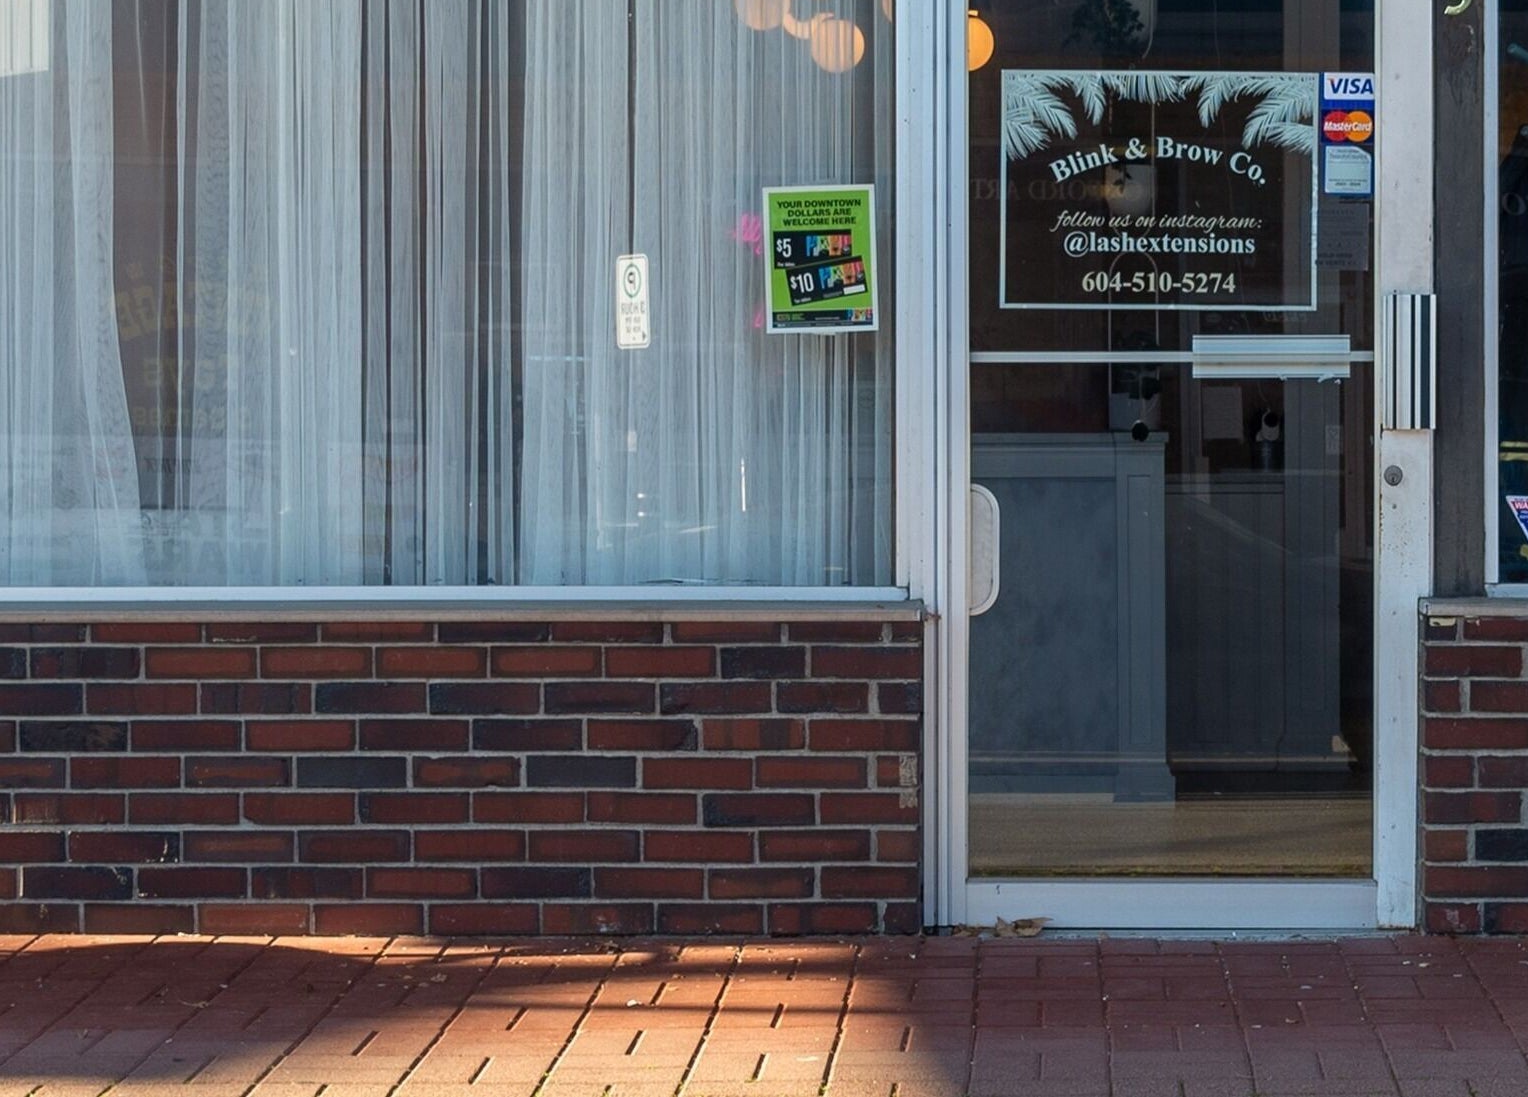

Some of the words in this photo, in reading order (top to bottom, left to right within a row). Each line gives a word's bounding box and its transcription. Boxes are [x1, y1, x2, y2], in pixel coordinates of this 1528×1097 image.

[1328, 78, 1374, 94] VISA
[1323, 121, 1373, 133] MasterCard
[1048, 143, 1121, 183] Blink
[1124, 137, 1148, 160] &
[1156, 136, 1223, 166] Brow
[1229, 151, 1266, 185] Co.
[777, 200, 803, 209] YOUR
[804, 198, 861, 208] DOWNTOWN
[787, 208, 831, 217] DOLLARS
[832, 207, 852, 216] ARE
[782, 217, 829, 227] WELCOME
[831, 216, 857, 225] HERE
[1049, 210, 1105, 233] follow
[1108, 213, 1133, 228] us
[1135, 215, 1157, 228] on
[1158, 213, 1263, 234] instagram:
[775, 237, 793, 258] $5
[1063, 230, 1256, 258] @lashextensions
[789, 272, 815, 294] $10
[1081, 271, 1236, 294] 604-510-5274
